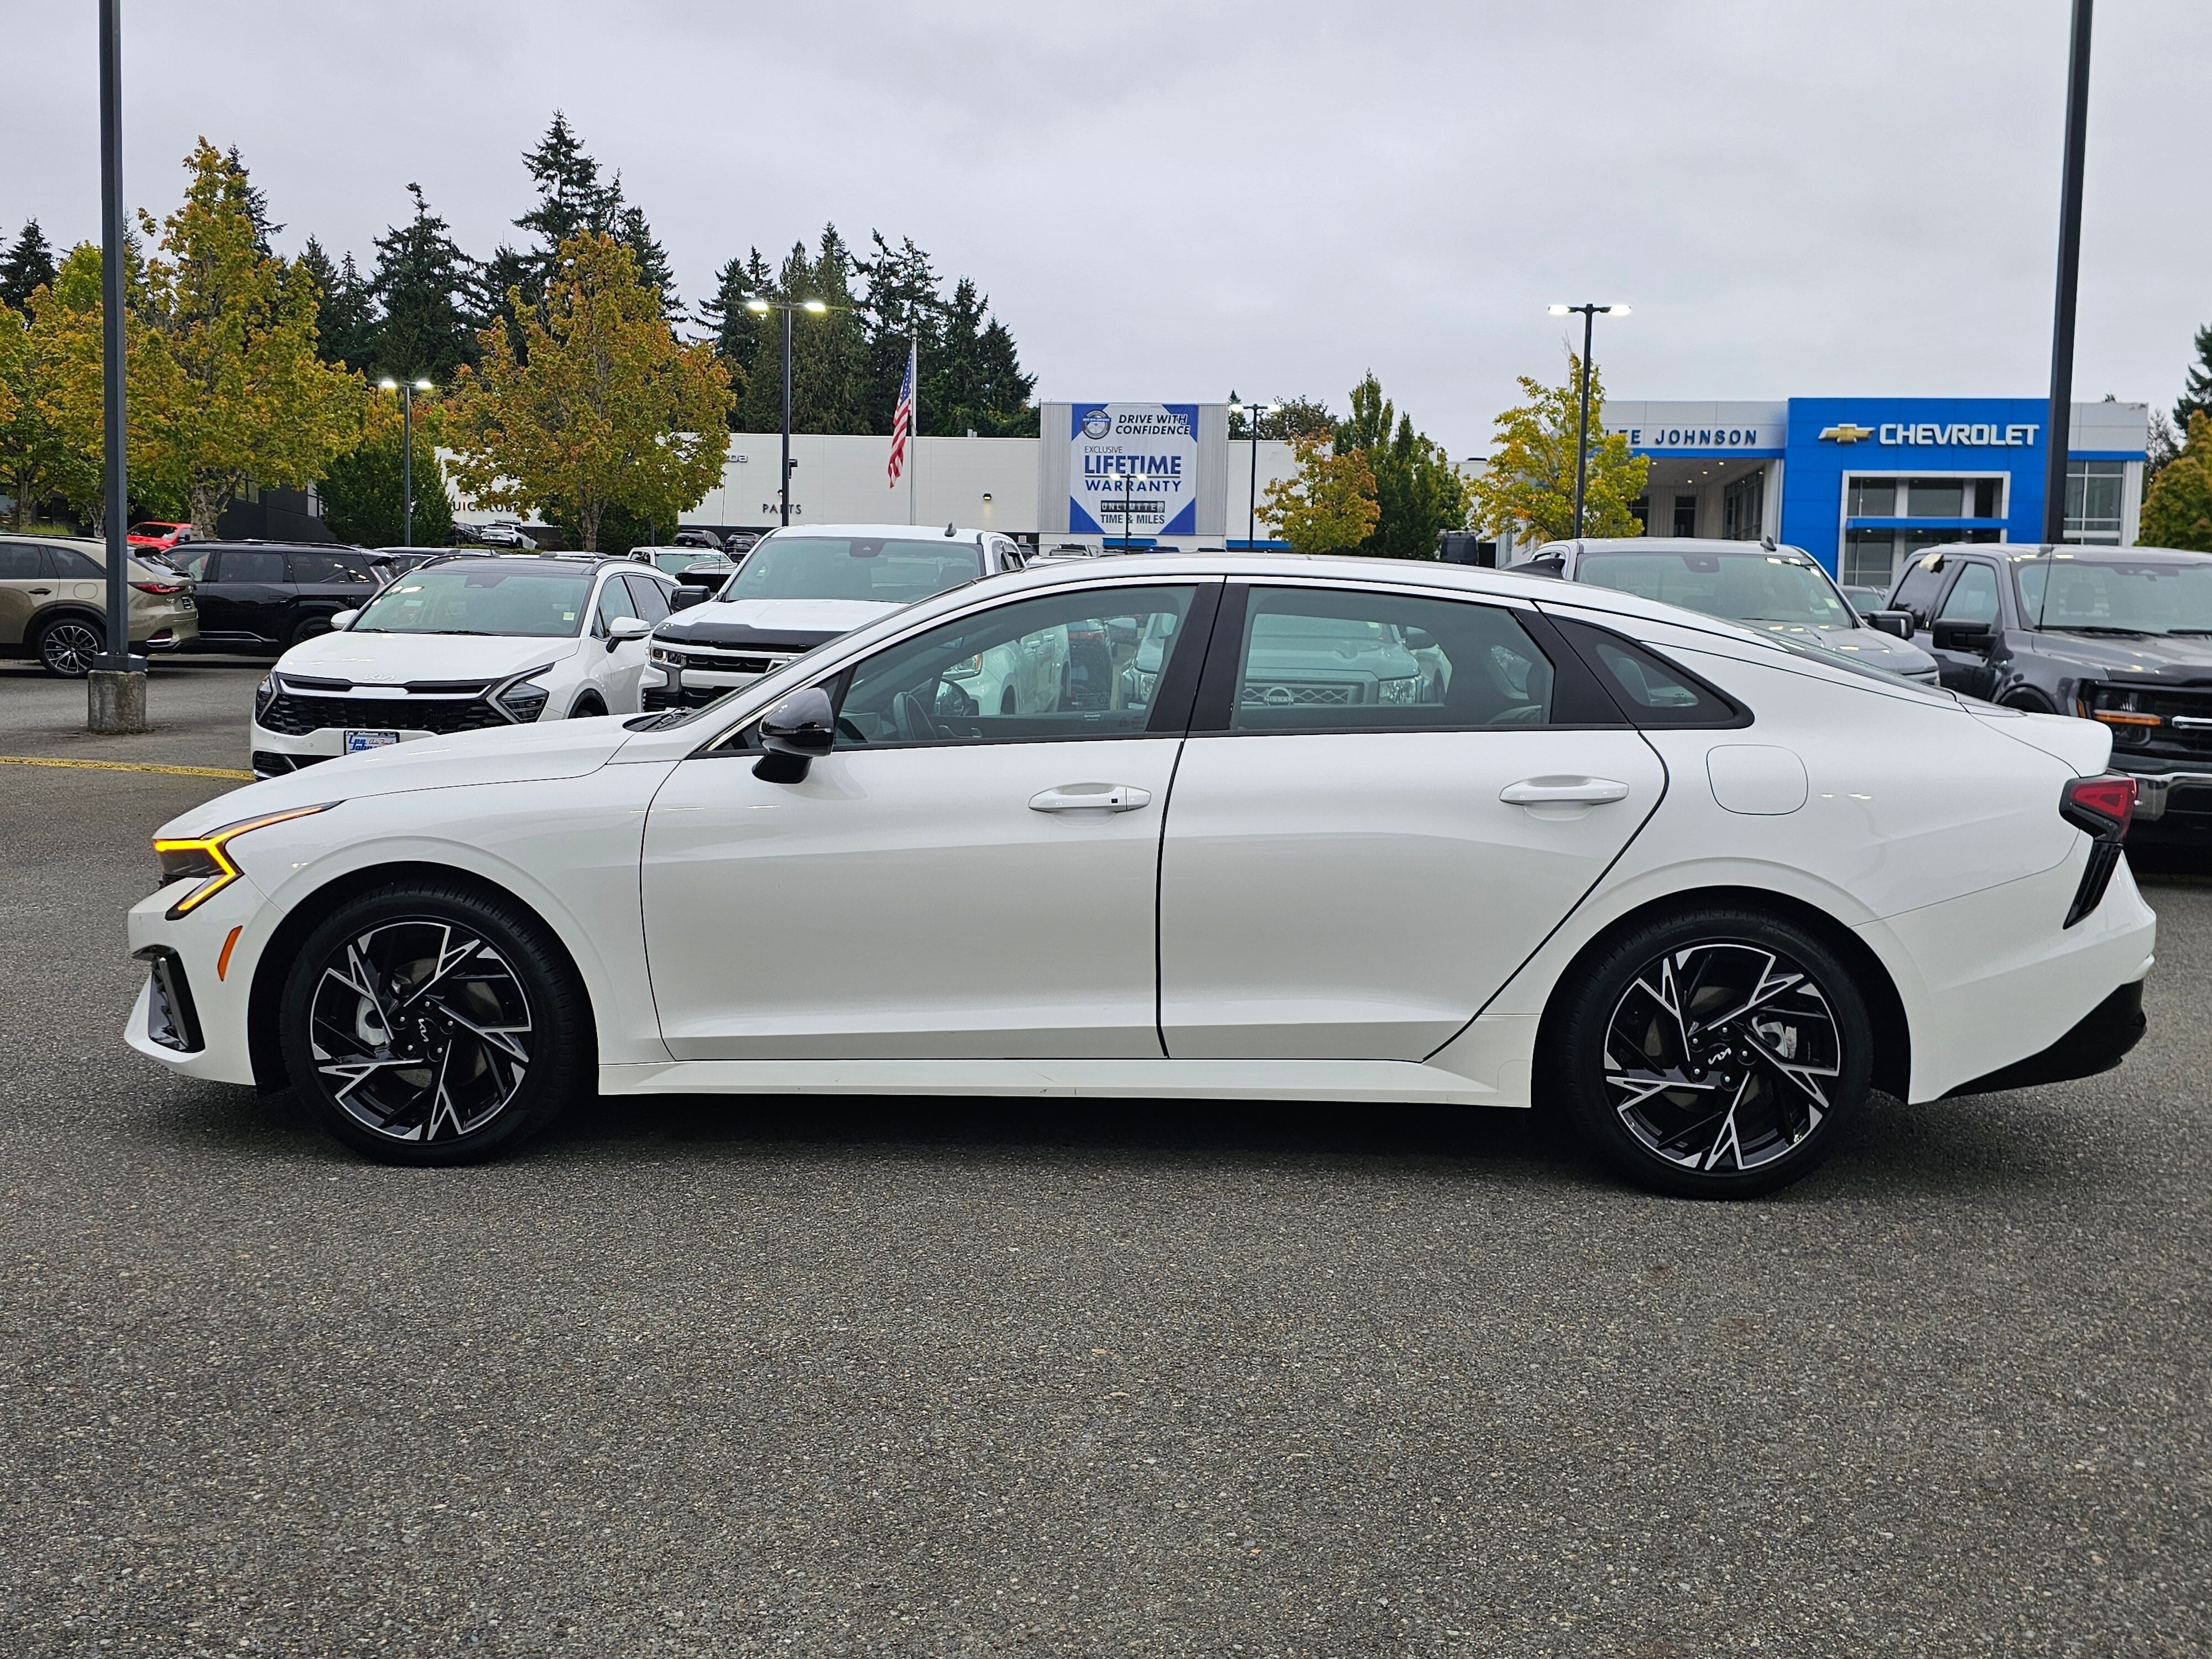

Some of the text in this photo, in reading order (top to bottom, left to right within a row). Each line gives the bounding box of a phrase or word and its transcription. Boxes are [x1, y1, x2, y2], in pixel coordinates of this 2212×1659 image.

[1119, 415, 1187, 424] DRIVE WITH
[1115, 425, 1190, 435] CONFIDENCE
[1880, 423, 2040, 446] CHEVROLET
[1655, 429, 1757, 445] JOHNSON
[1084, 455, 1181, 474] LIFETIME
[1100, 514, 1123, 523] TIME
[1136, 514, 1165, 524] MILES
